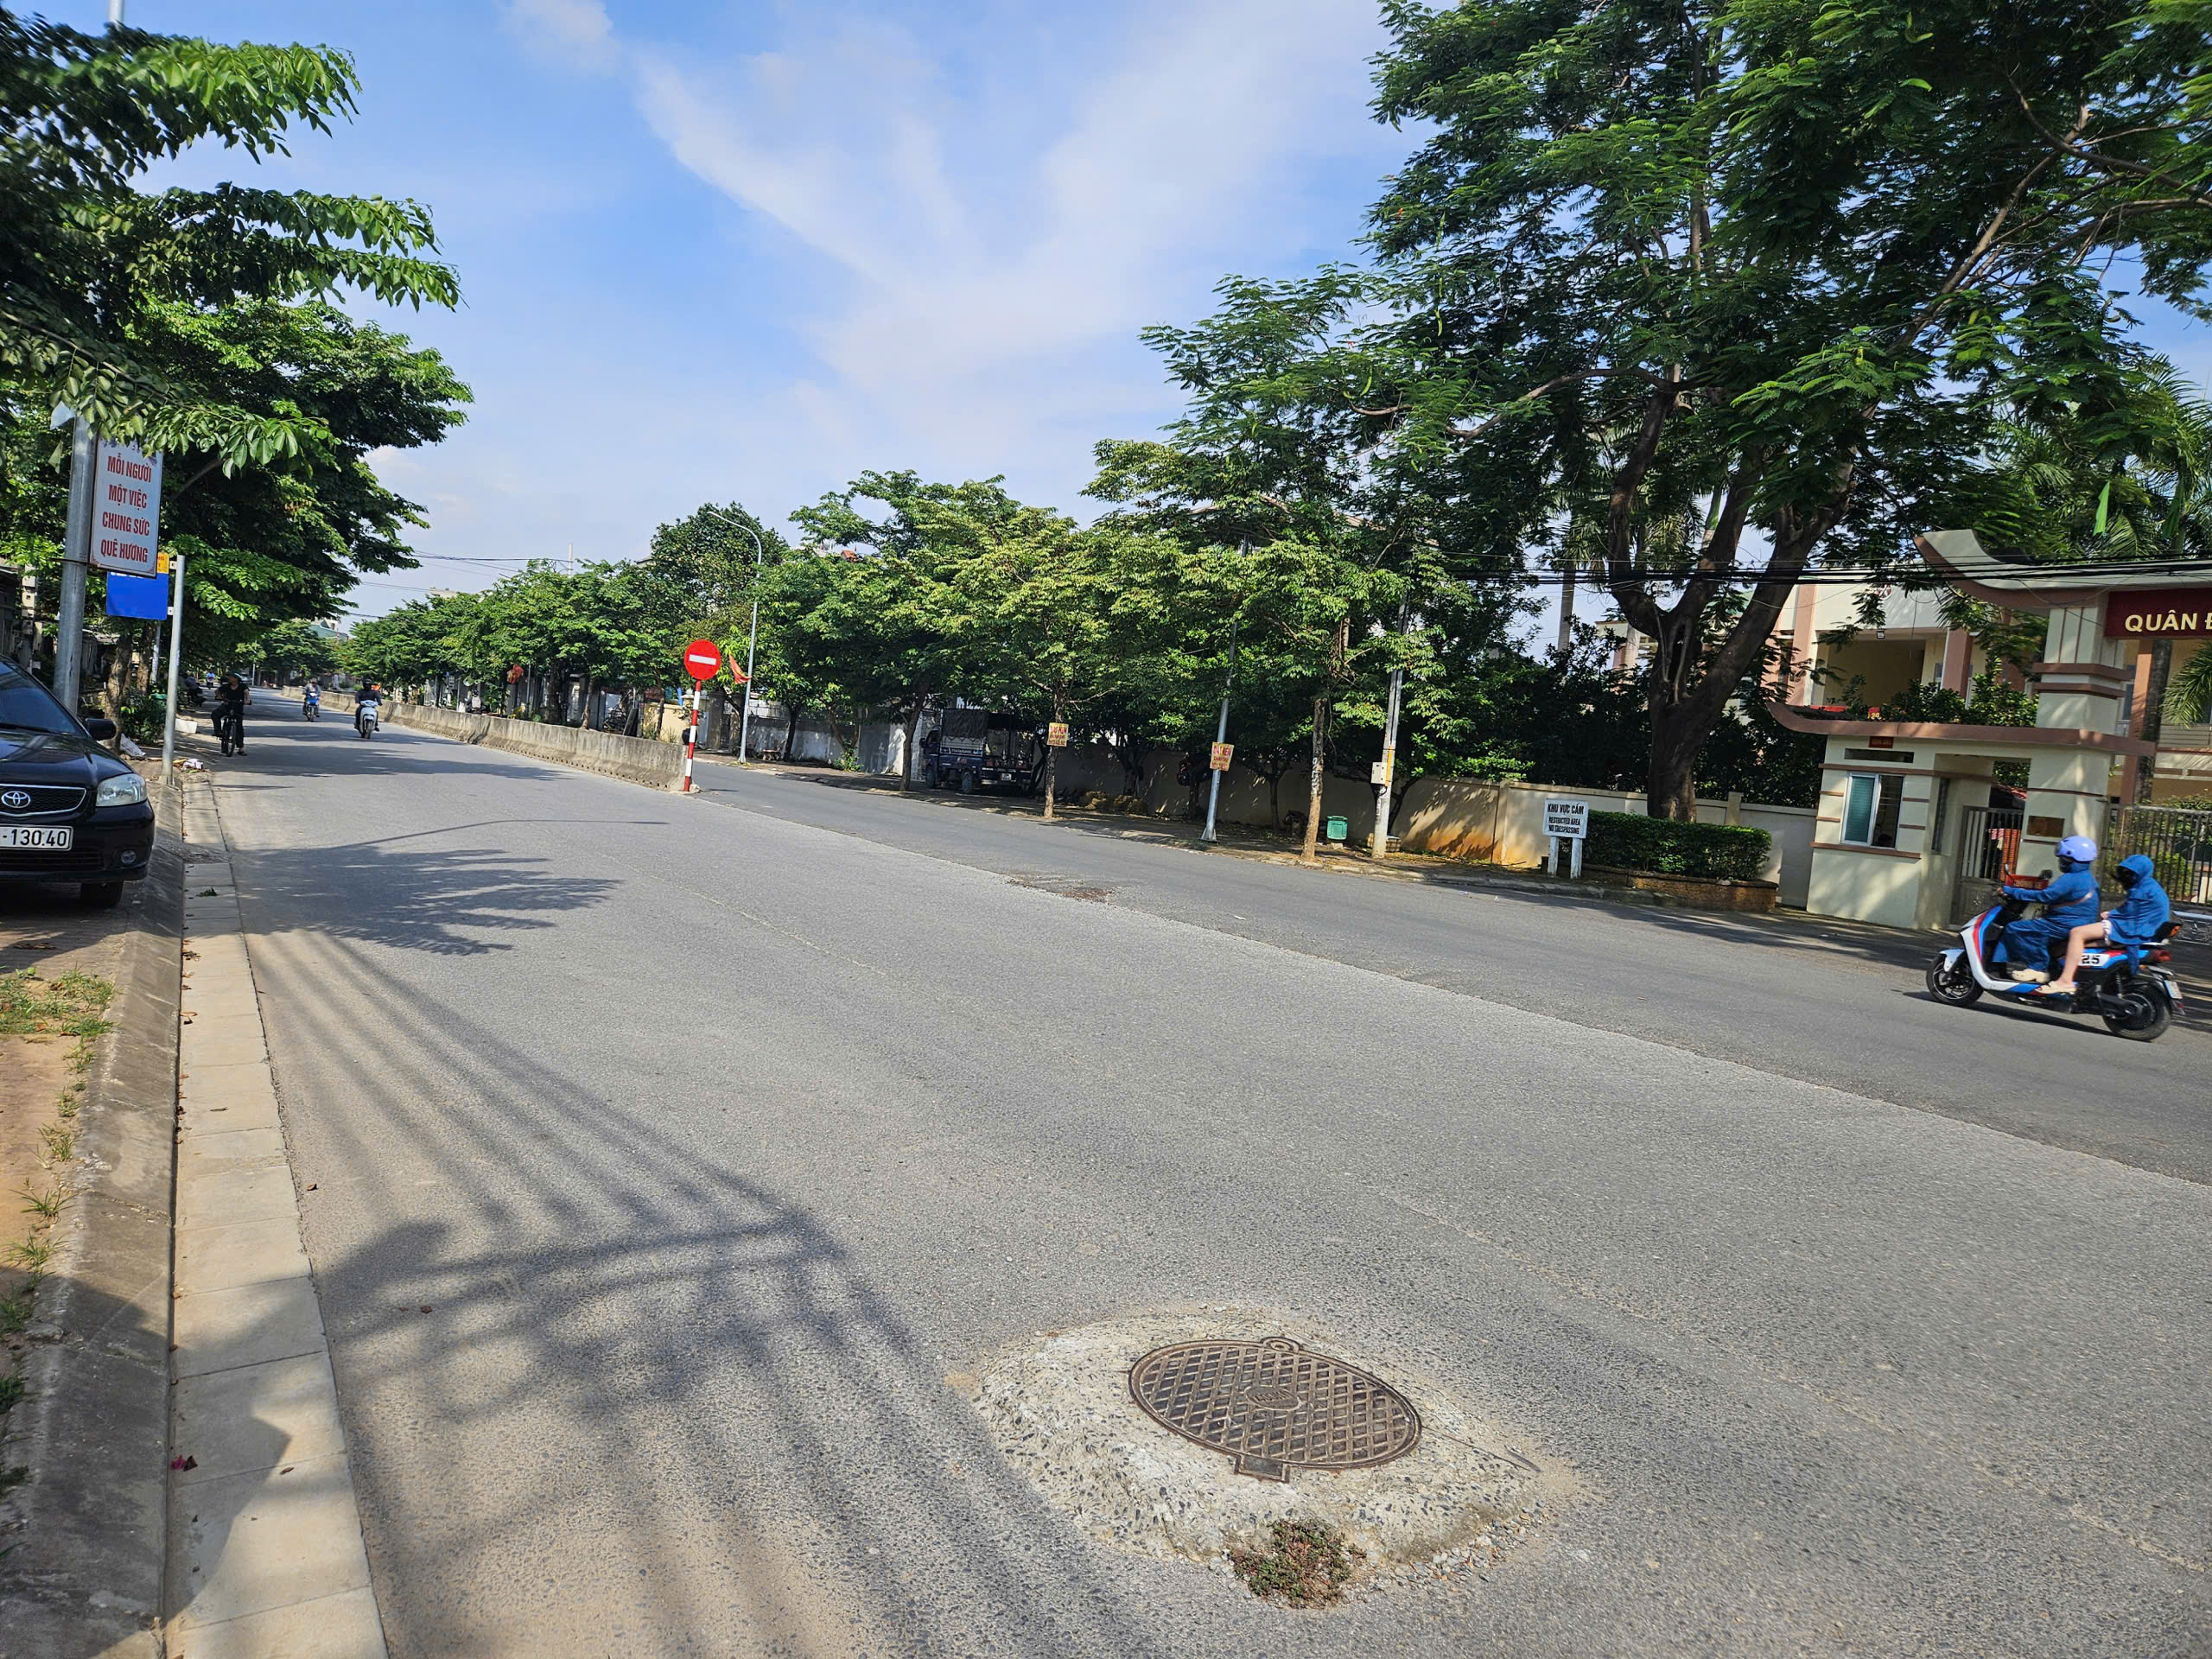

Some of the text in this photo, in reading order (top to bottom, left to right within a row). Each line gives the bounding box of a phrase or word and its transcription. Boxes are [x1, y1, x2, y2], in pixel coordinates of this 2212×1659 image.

[107, 453, 152, 483] MỖI NGƯỜI
[109, 484, 148, 512] MỘT VIỆC
[102, 512, 150, 536] CHUNG SỨC
[100, 538, 149, 563] QUÊ HƯƠNG
[2125, 609, 2198, 632] QUÂN
[1548, 804, 1558, 812] KHU
